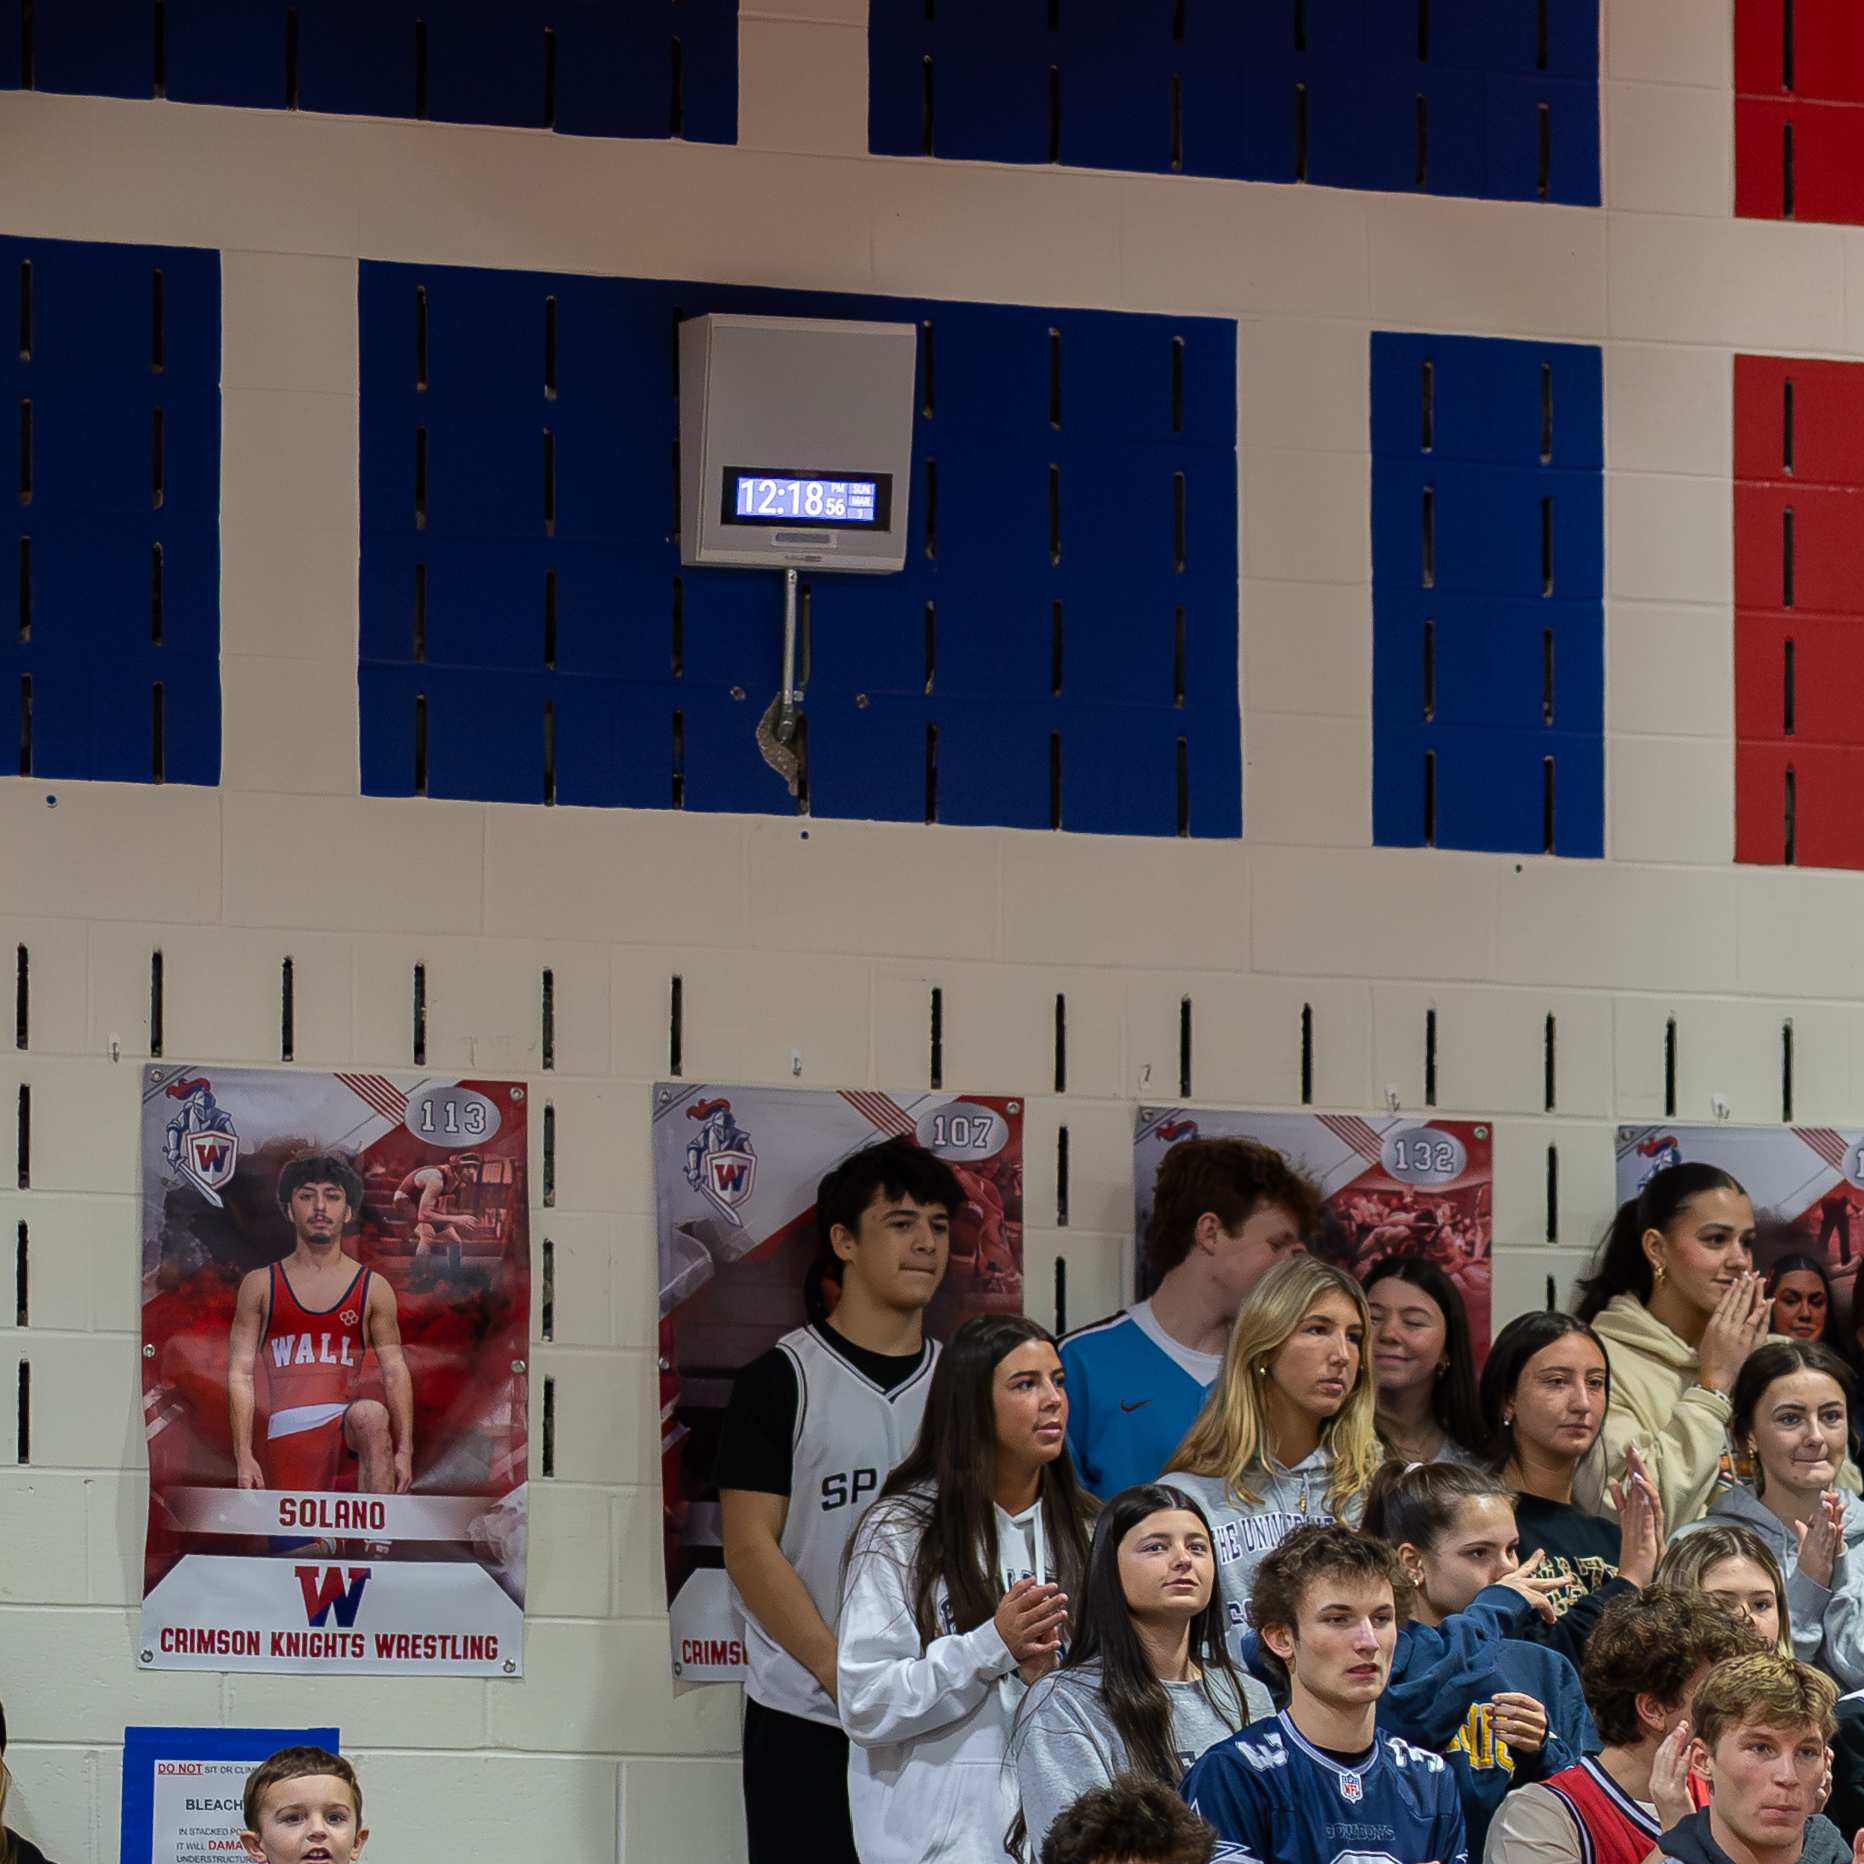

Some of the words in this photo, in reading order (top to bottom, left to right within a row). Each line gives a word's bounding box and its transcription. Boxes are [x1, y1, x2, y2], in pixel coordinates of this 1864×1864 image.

[741, 480, 824, 516] 12:18
[826, 498, 845, 516] 56
[421, 1099, 487, 1135] 113
[933, 1116, 993, 1148] 107
[195, 1145, 231, 1173] W
[1394, 1141, 1455, 1173] 132
[714, 1162, 748, 1192] W
[270, 1332, 354, 1368] WALL
[279, 1498, 385, 1530] SOLANO
[295, 1566, 372, 1627] W
[160, 1628, 261, 1657] CRIMSON
[270, 1631, 365, 1659] KNIGHTS
[374, 1633, 499, 1661] WRESTLING
[158, 1763, 175, 1775] DO
[178, 1763, 203, 1775] NOT
